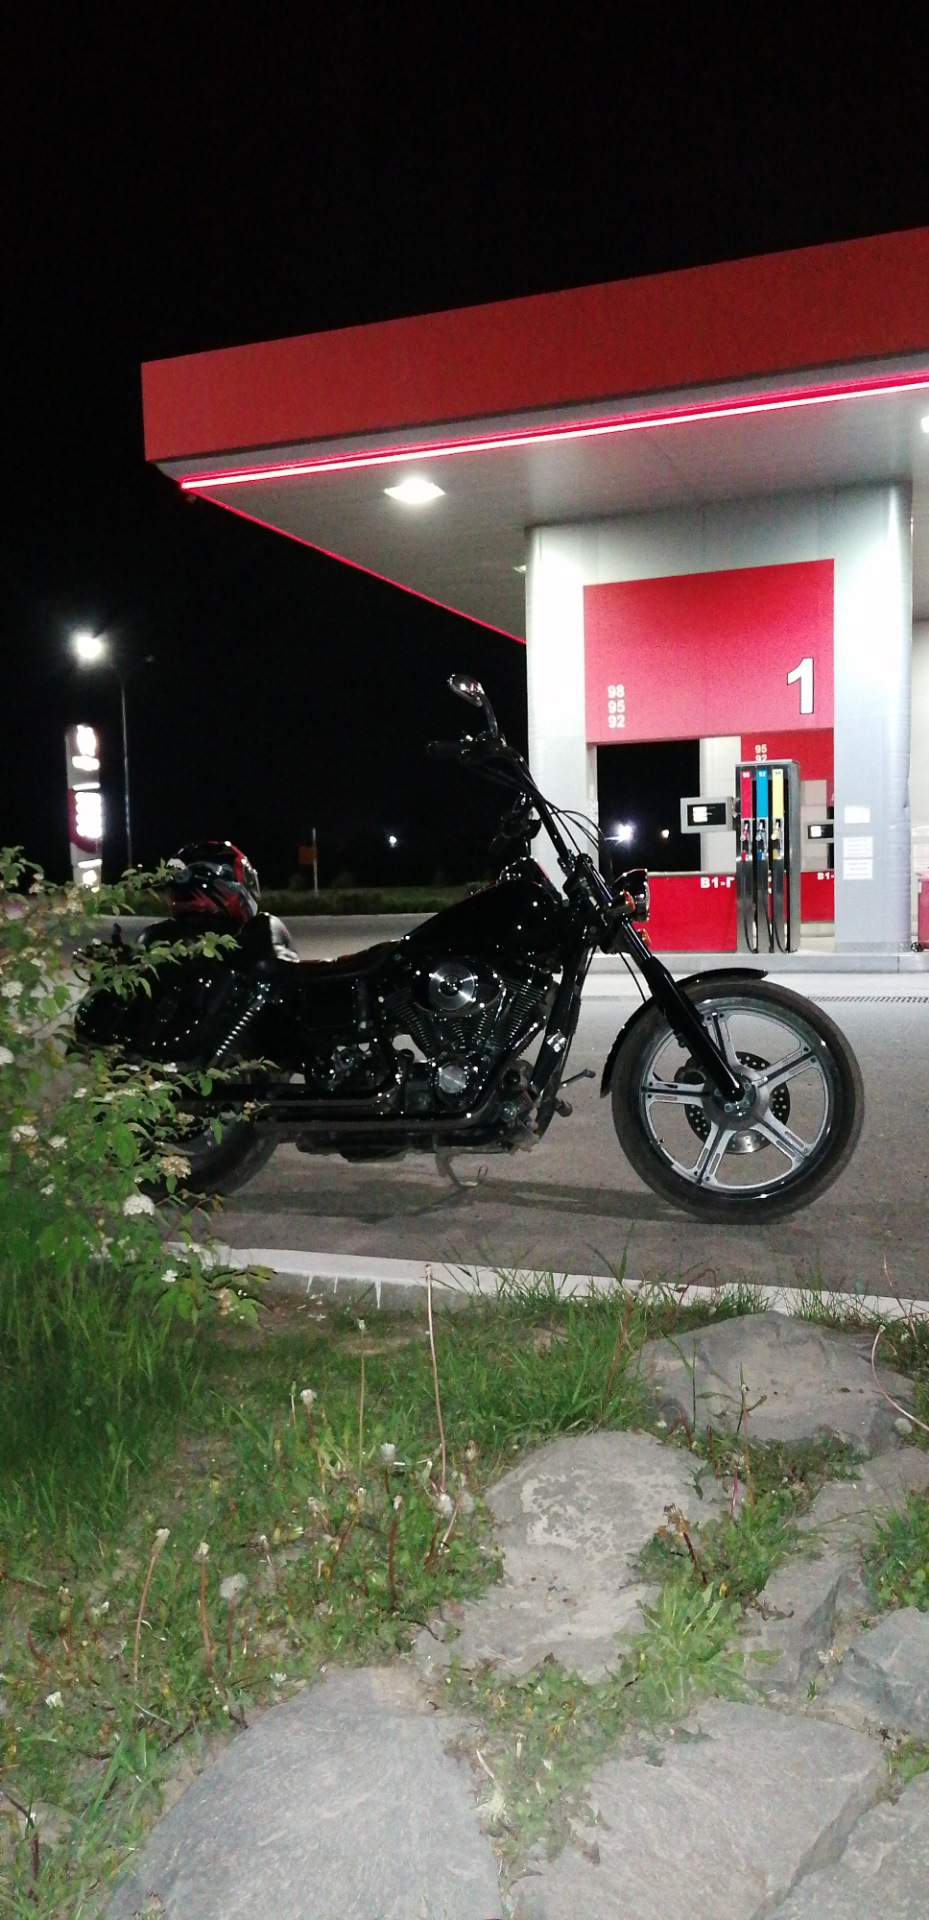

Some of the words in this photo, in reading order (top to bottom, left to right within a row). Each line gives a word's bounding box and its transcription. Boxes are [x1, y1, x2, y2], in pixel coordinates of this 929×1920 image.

[607, 685, 625, 699] 98
[787, 657, 814, 715] 1
[608, 700, 625, 714] 95
[608, 715, 626, 728] 92
[755, 744, 767, 754] 95
